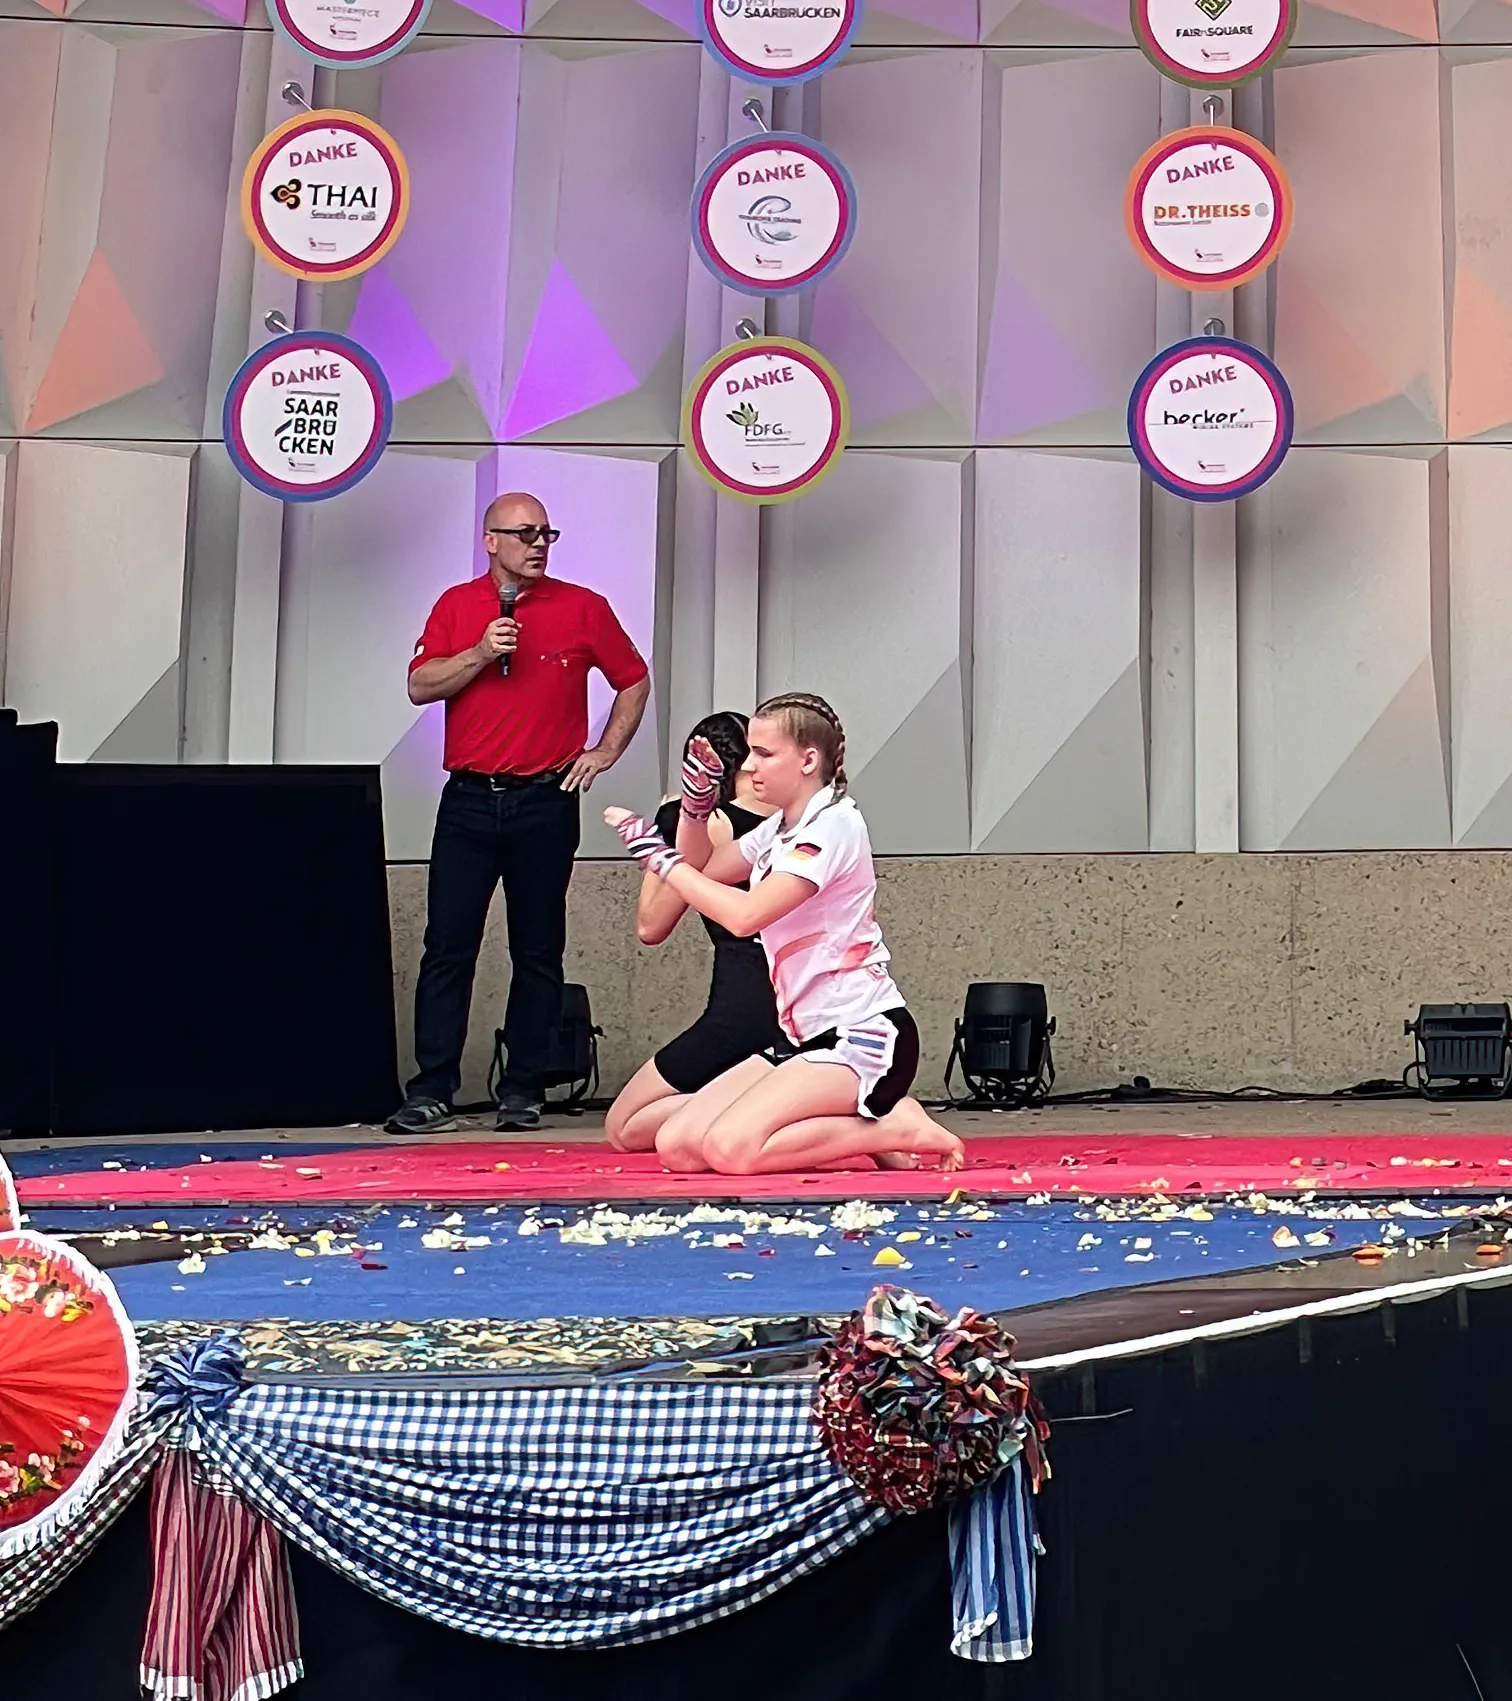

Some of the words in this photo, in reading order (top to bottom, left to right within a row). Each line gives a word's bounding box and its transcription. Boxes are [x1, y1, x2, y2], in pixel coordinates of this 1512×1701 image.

[289, 142, 358, 168] DANKE
[737, 163, 806, 186] DANKE
[1166, 155, 1235, 184] DANKE
[307, 184, 378, 208] THAI
[272, 363, 341, 387] DANKE
[726, 366, 794, 395] DANKE
[1169, 365, 1237, 395] DANKE
[284, 398, 338, 418] SAAR
[745, 423, 783, 436] FDFG
[279, 436, 334, 456] CKEN
